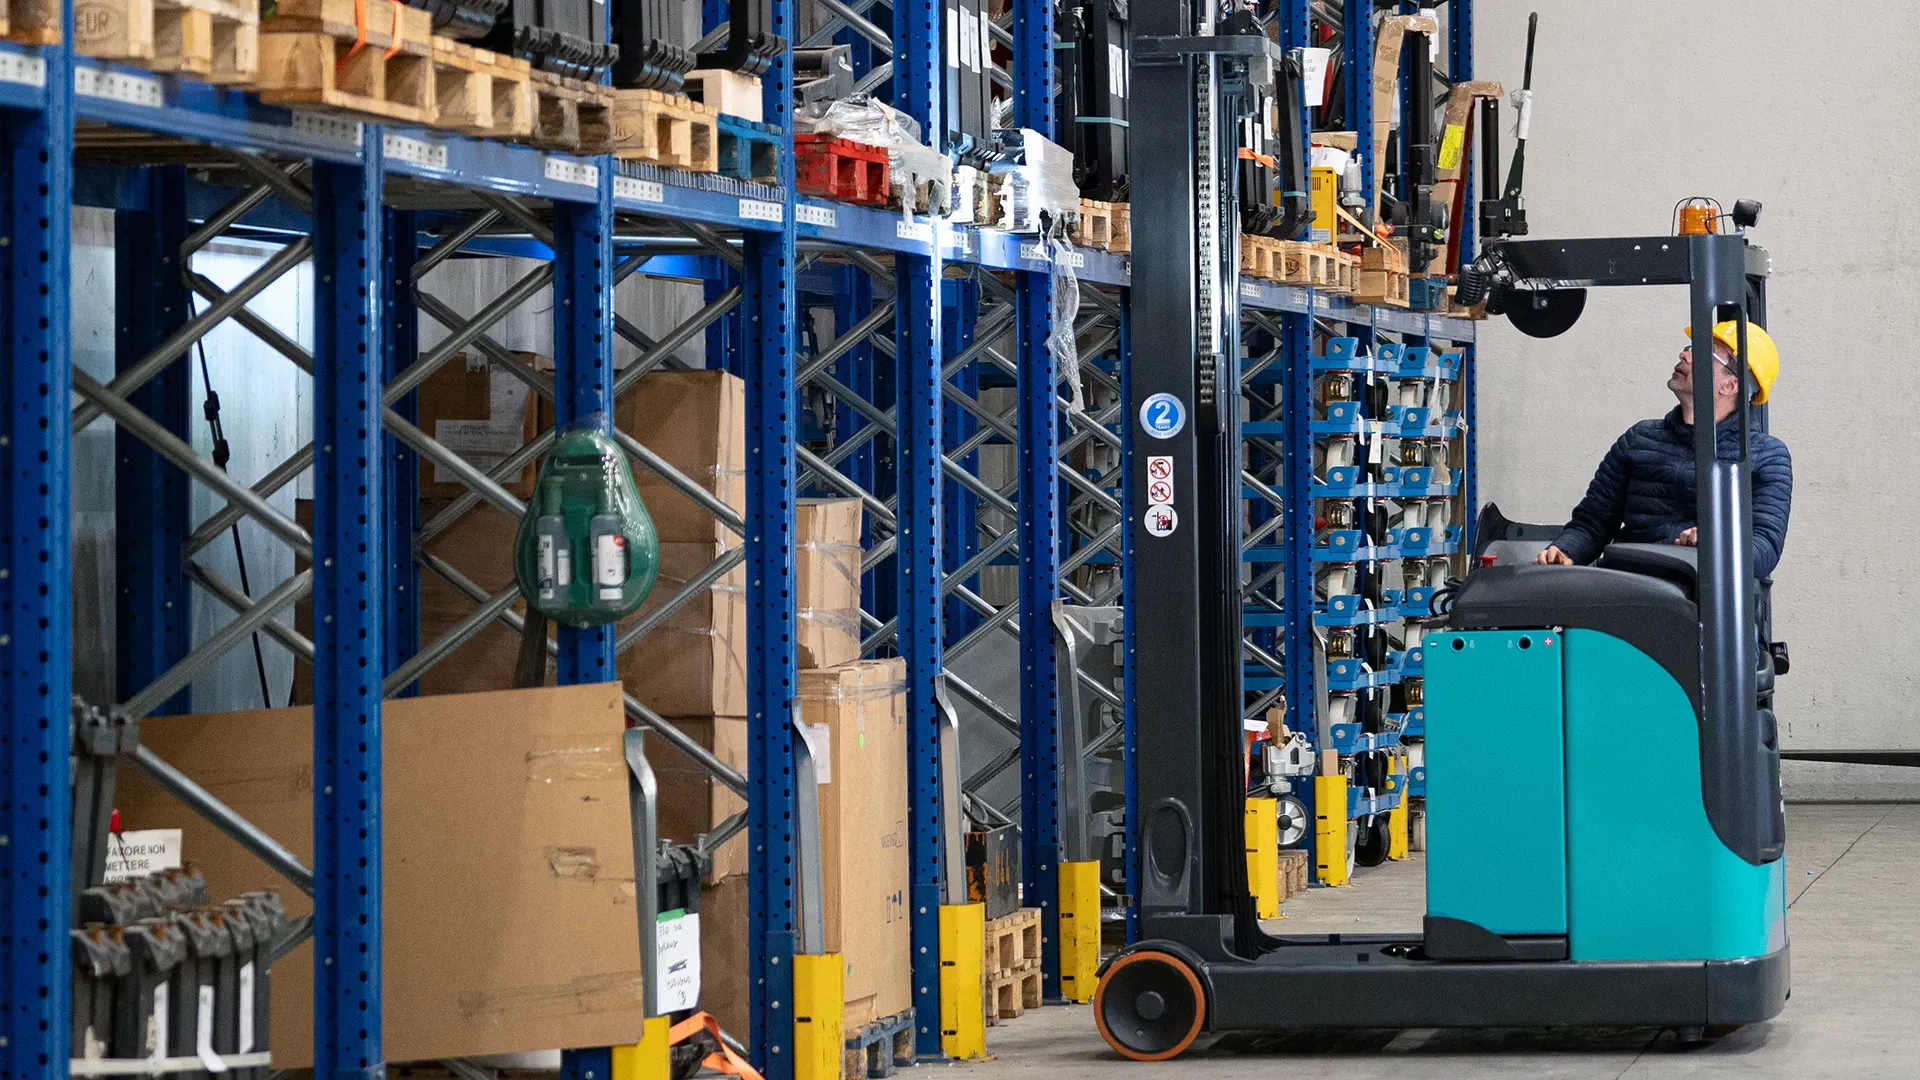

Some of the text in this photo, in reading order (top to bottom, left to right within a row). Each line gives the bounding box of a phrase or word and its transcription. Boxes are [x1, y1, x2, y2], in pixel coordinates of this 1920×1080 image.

[75, 11, 108, 34] EUR
[1155, 401, 1170, 423] 2
[148, 843, 166, 854] NON
[106, 859, 150, 872] METTERE
